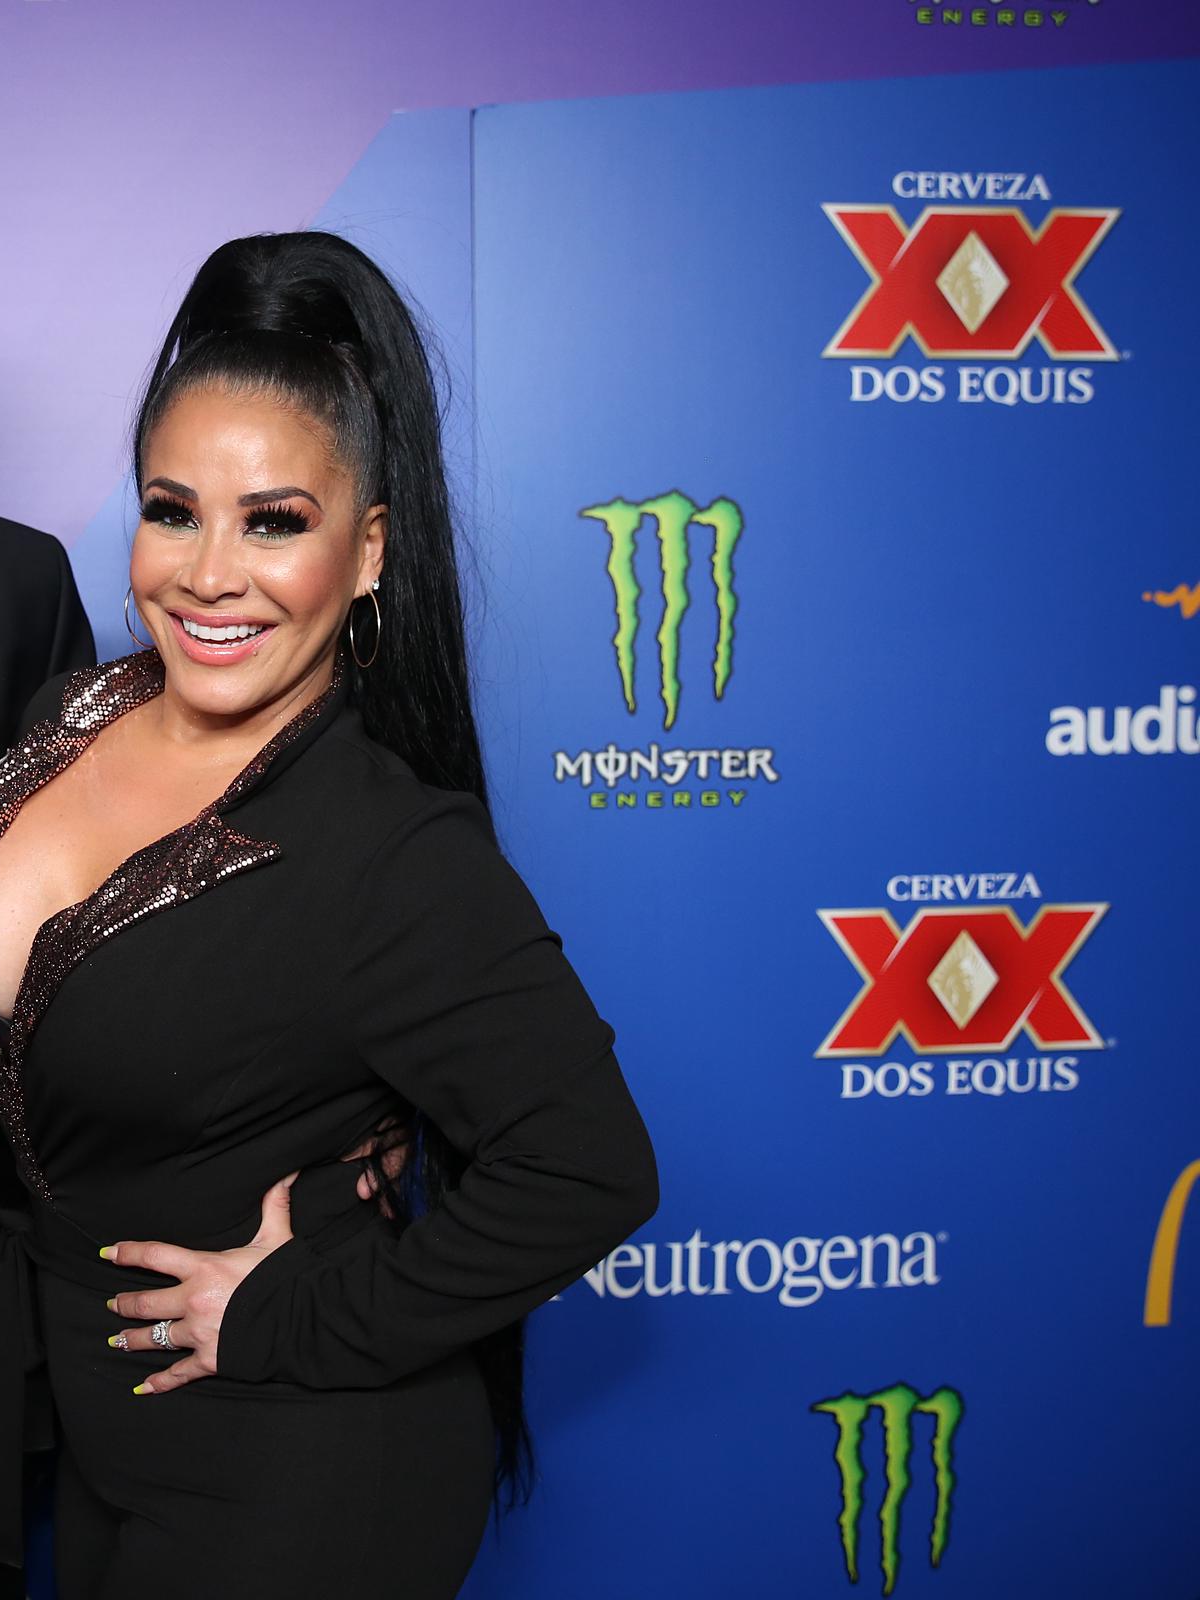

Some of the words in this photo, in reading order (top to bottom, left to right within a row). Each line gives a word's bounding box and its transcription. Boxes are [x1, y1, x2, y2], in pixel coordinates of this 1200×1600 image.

[916, 8, 1067, 26] ENERGY
[892, 171, 1051, 200] CERVEZA
[850, 365, 945, 402] DOS
[958, 367, 1094, 406] EQUIS
[1045, 684, 1200, 757] audi
[554, 743, 779, 788] MONSTER
[590, 790, 746, 808] ENERGY
[886, 872, 1042, 901] CERVEZA
[841, 1061, 934, 1098] DOS
[946, 1056, 1080, 1096] EQUIS
